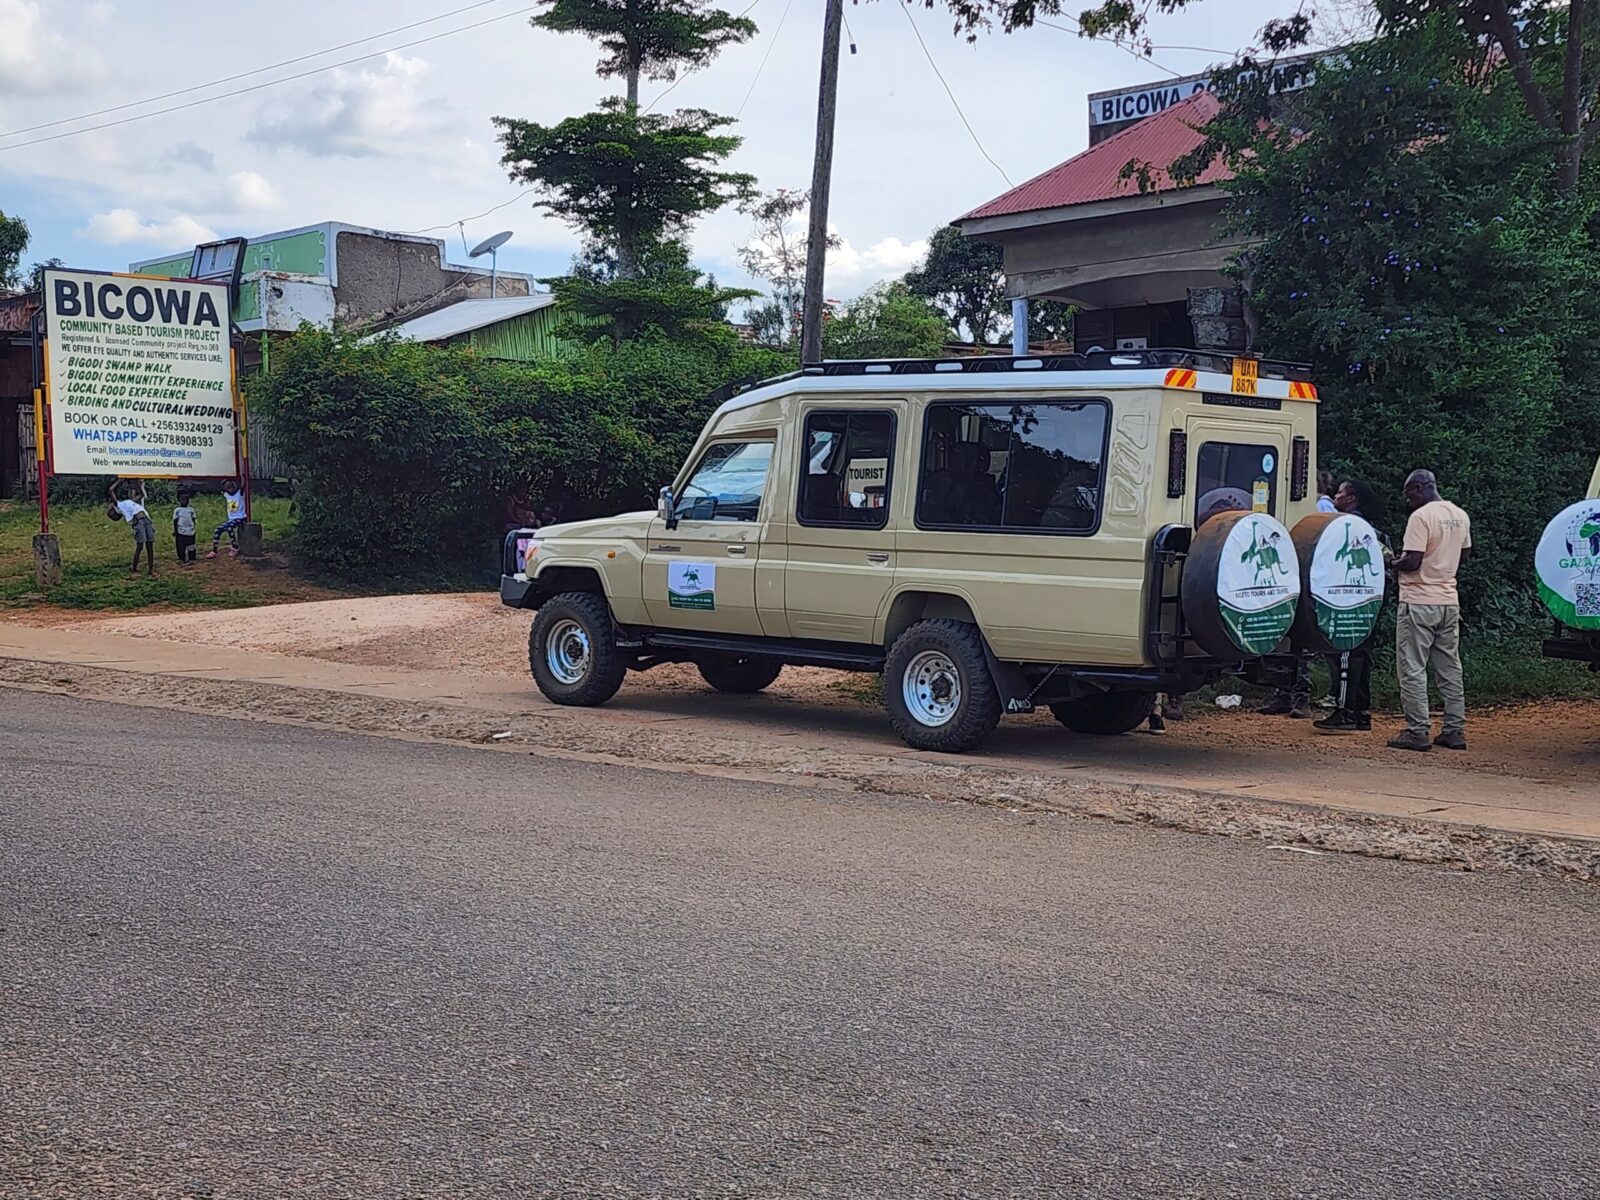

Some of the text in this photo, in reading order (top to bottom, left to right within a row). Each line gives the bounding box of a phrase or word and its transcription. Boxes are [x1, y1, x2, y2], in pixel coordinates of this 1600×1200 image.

[1102, 88, 1181, 121] BICOWA
[54, 279, 221, 327] BICOWA
[60, 320, 221, 342] COMMUNITY BASED TOURISM PROJECT
[61, 333, 94, 343] Registered
[96, 335, 100, 343] &
[105, 336, 130, 345] licensed
[131, 338, 165, 349] Community
[166, 341, 187, 350] project
[61, 343, 71, 352] WE
[72, 344, 92, 354] OFFER
[93, 346, 105, 355] EYE
[106, 347, 131, 357] QUALITY
[132, 350, 145, 358] AND
[146, 350, 179, 361] AUTHENTIC
[179, 353, 207, 361] SERVICES
[67, 356, 172, 374] BIGODI SWAMP WALK
[1240, 361, 1256, 377] UAX
[67, 369, 224, 392] BIGODI COMMUNITY EXPERIENCE
[1235, 377, 1256, 394] 887K
[67, 382, 188, 400] LOCAL FOOD EXPERIENCE
[67, 395, 110, 409] BIRDING
[64, 412, 223, 434] BOOK OR CALL +256393249129
[73, 428, 214, 447] WHATSAPP +256788908393
[112, 458, 193, 469] www.bicowalocals.com
[848, 467, 885, 480] TOURIST
